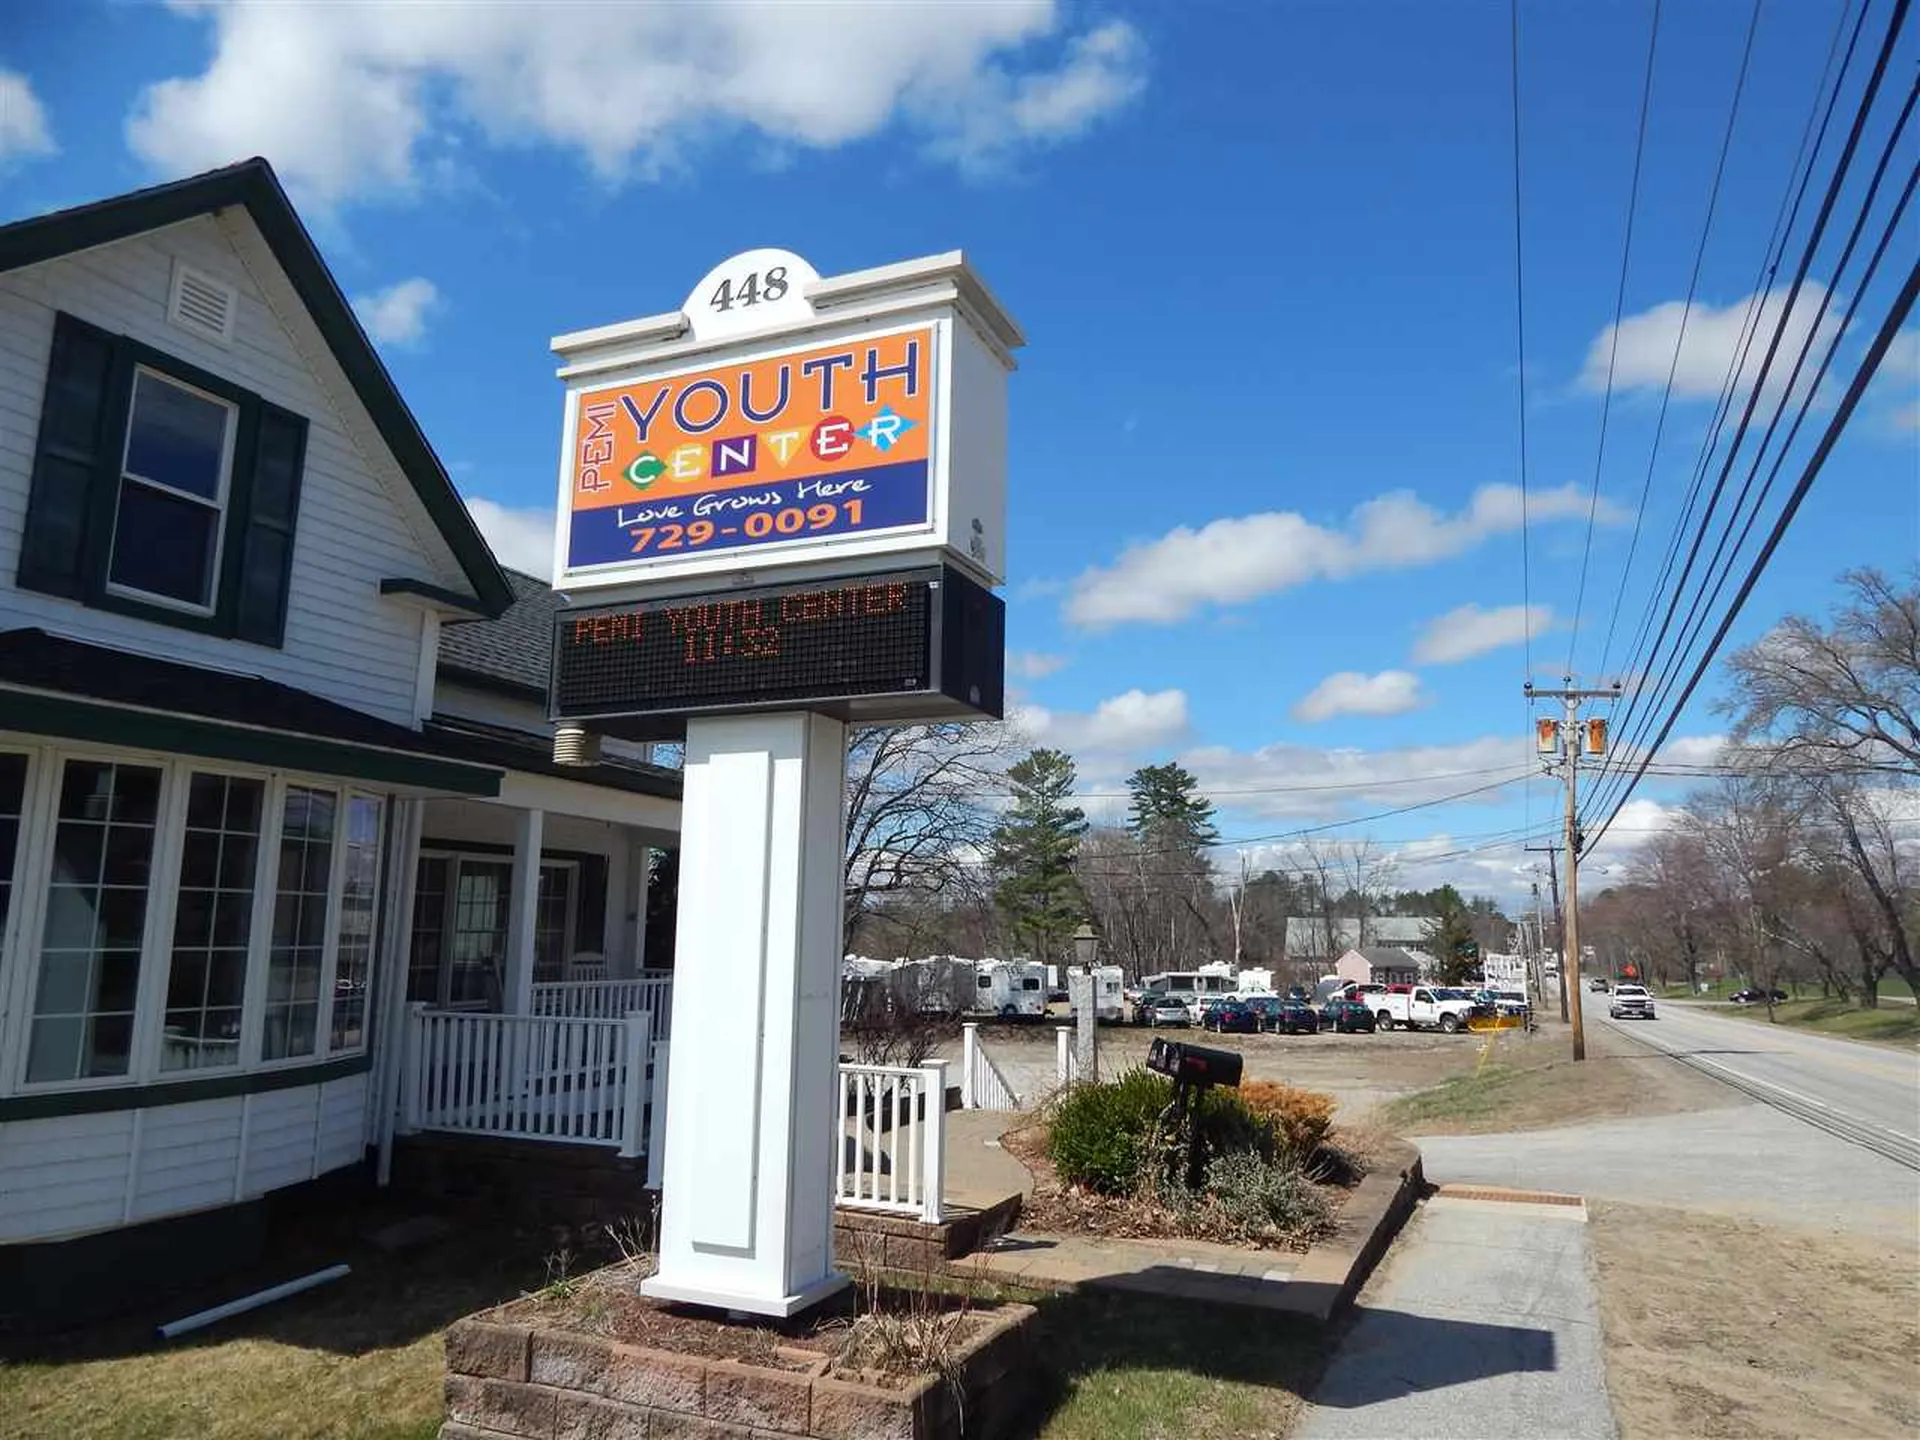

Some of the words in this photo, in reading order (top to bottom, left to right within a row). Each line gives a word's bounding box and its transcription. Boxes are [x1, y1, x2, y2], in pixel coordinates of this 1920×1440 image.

[710, 266, 789, 312] 448
[620, 340, 919, 442] YOUTH
[580, 402, 615, 492] PEMI
[629, 414, 901, 484] CENTER
[618, 508, 684, 528] Love
[693, 493, 782, 517] Grows
[797, 478, 873, 499] Here
[630, 499, 864, 553] 729-0091
[782, 582, 909, 622] CENTER
